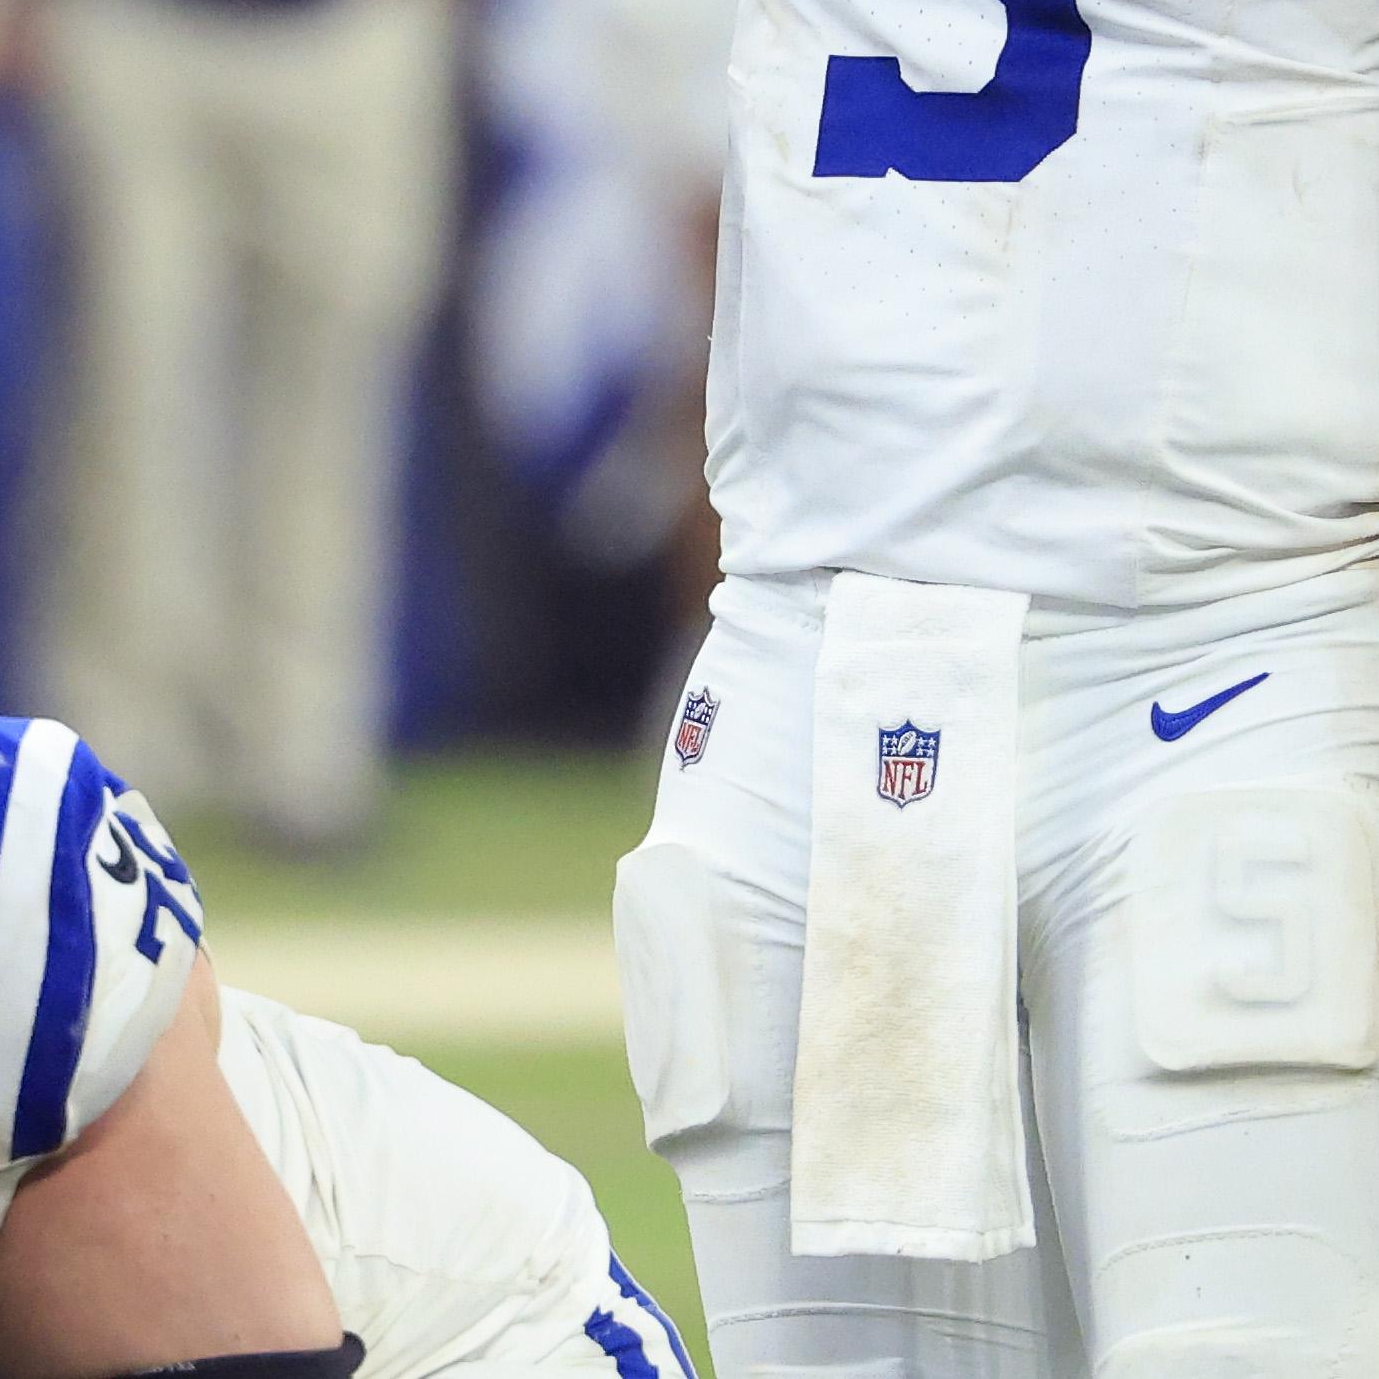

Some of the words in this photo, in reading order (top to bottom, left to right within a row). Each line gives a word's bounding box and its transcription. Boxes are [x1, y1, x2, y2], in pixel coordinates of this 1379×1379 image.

[678, 721, 703, 753] NFL
[882, 759, 929, 800] NFL
[1210, 816, 1318, 1005] 5
